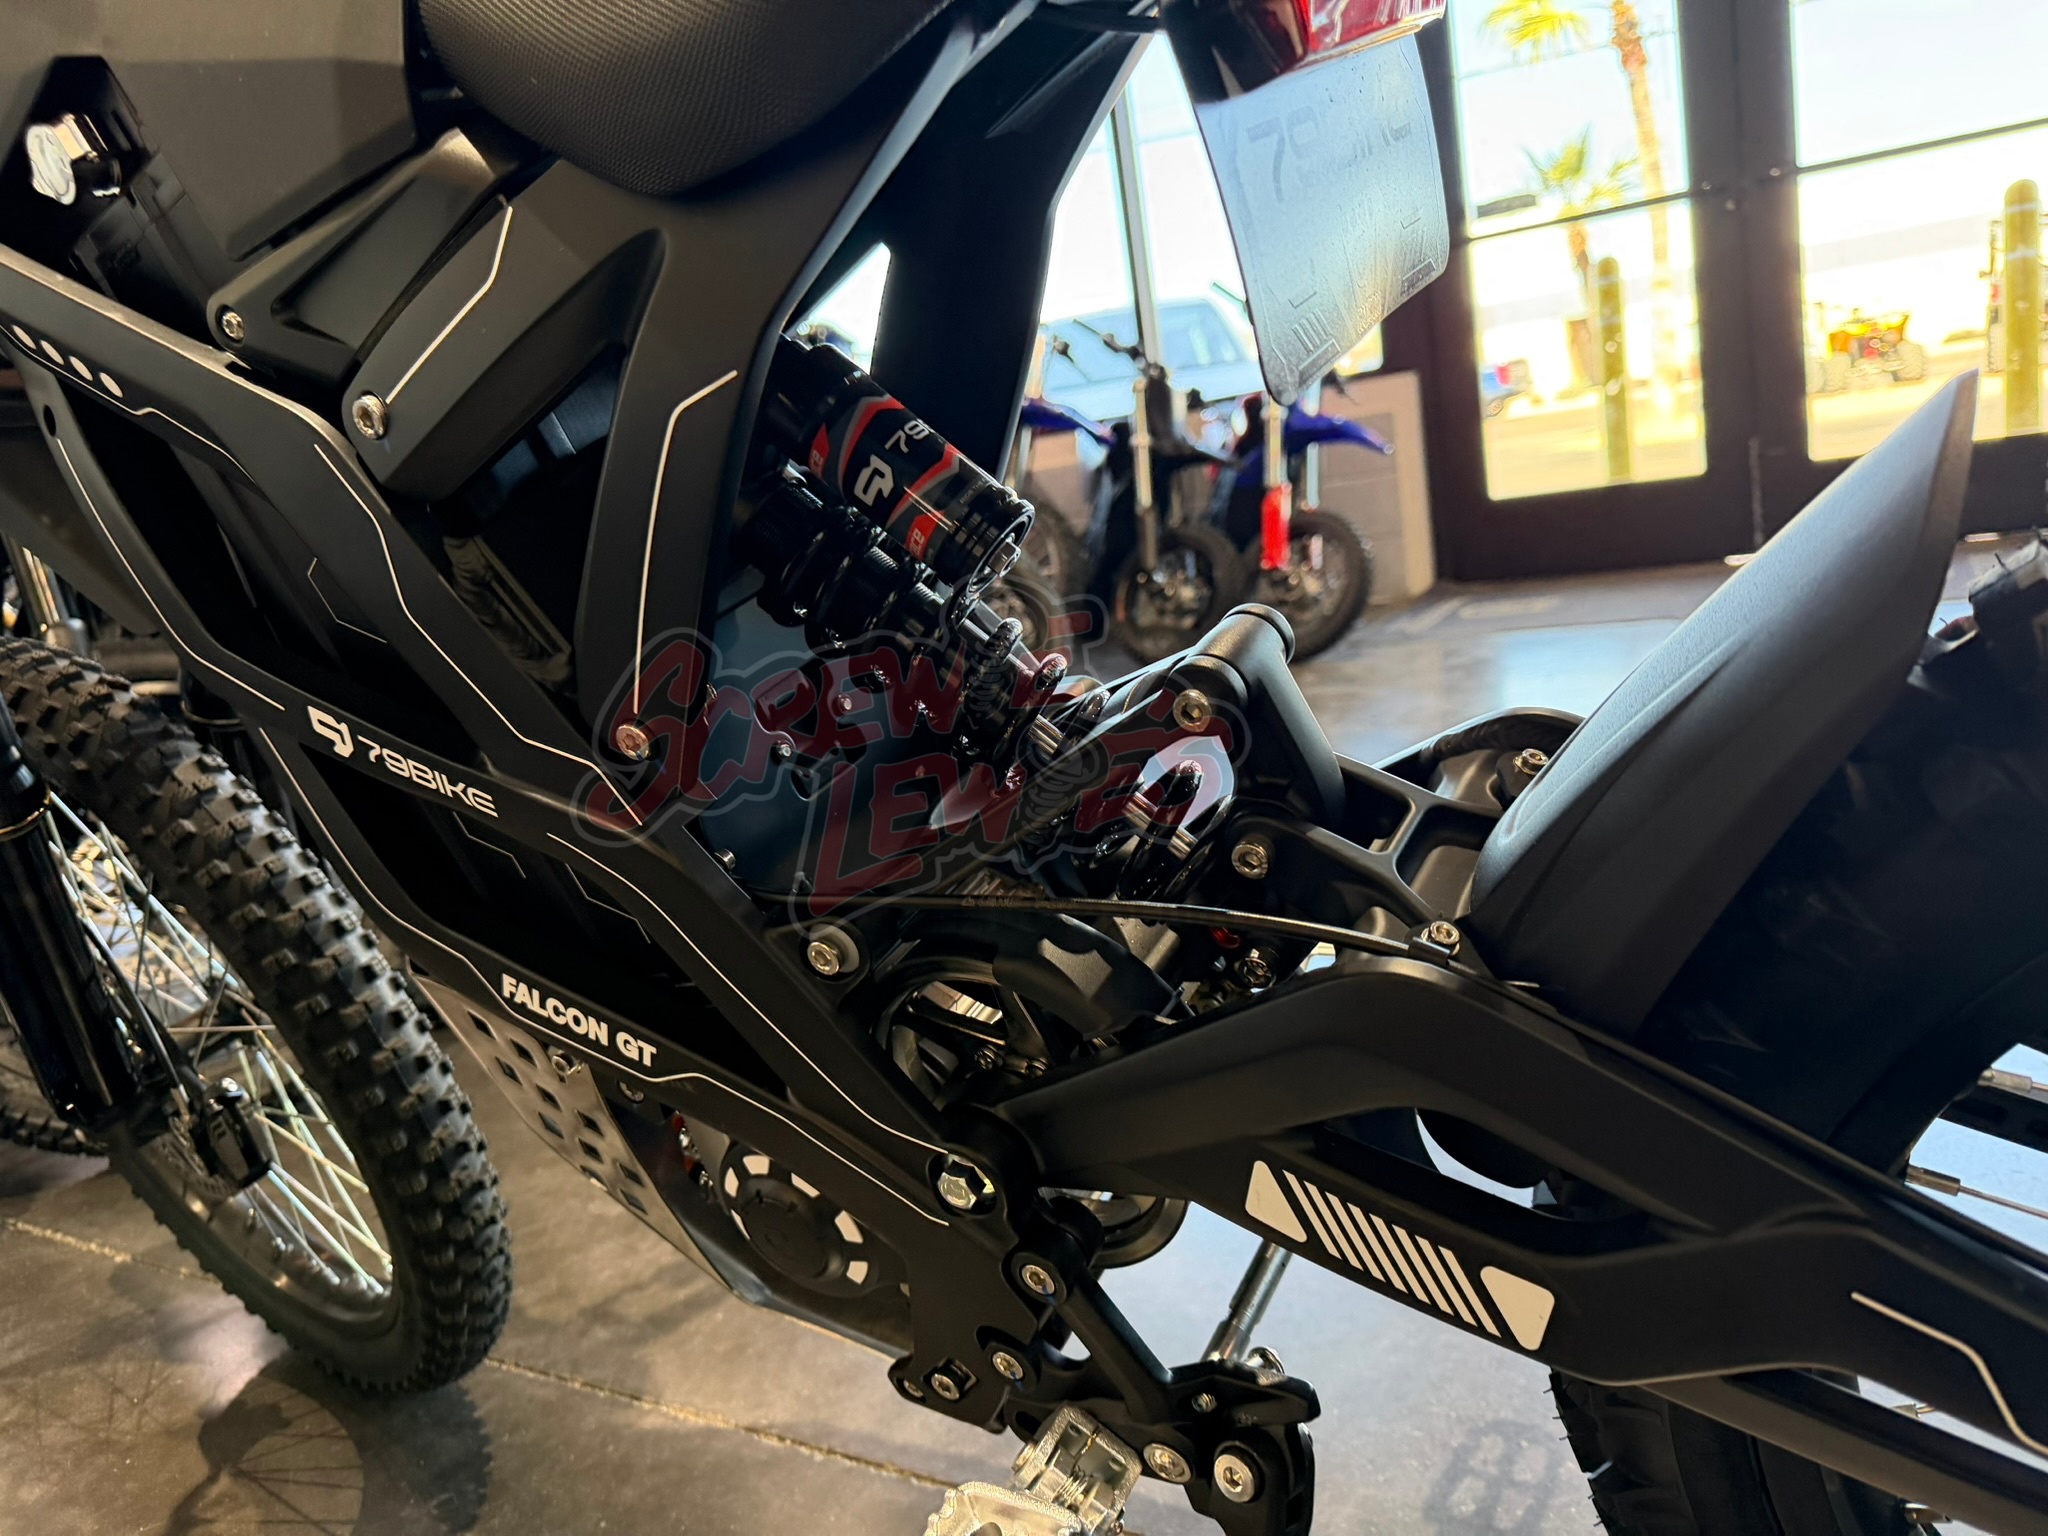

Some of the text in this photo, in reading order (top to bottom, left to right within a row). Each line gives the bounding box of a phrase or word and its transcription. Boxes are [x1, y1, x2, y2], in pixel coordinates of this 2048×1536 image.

[357, 734, 499, 818] 79BIKE
[502, 973, 657, 1067] FALCON GT
